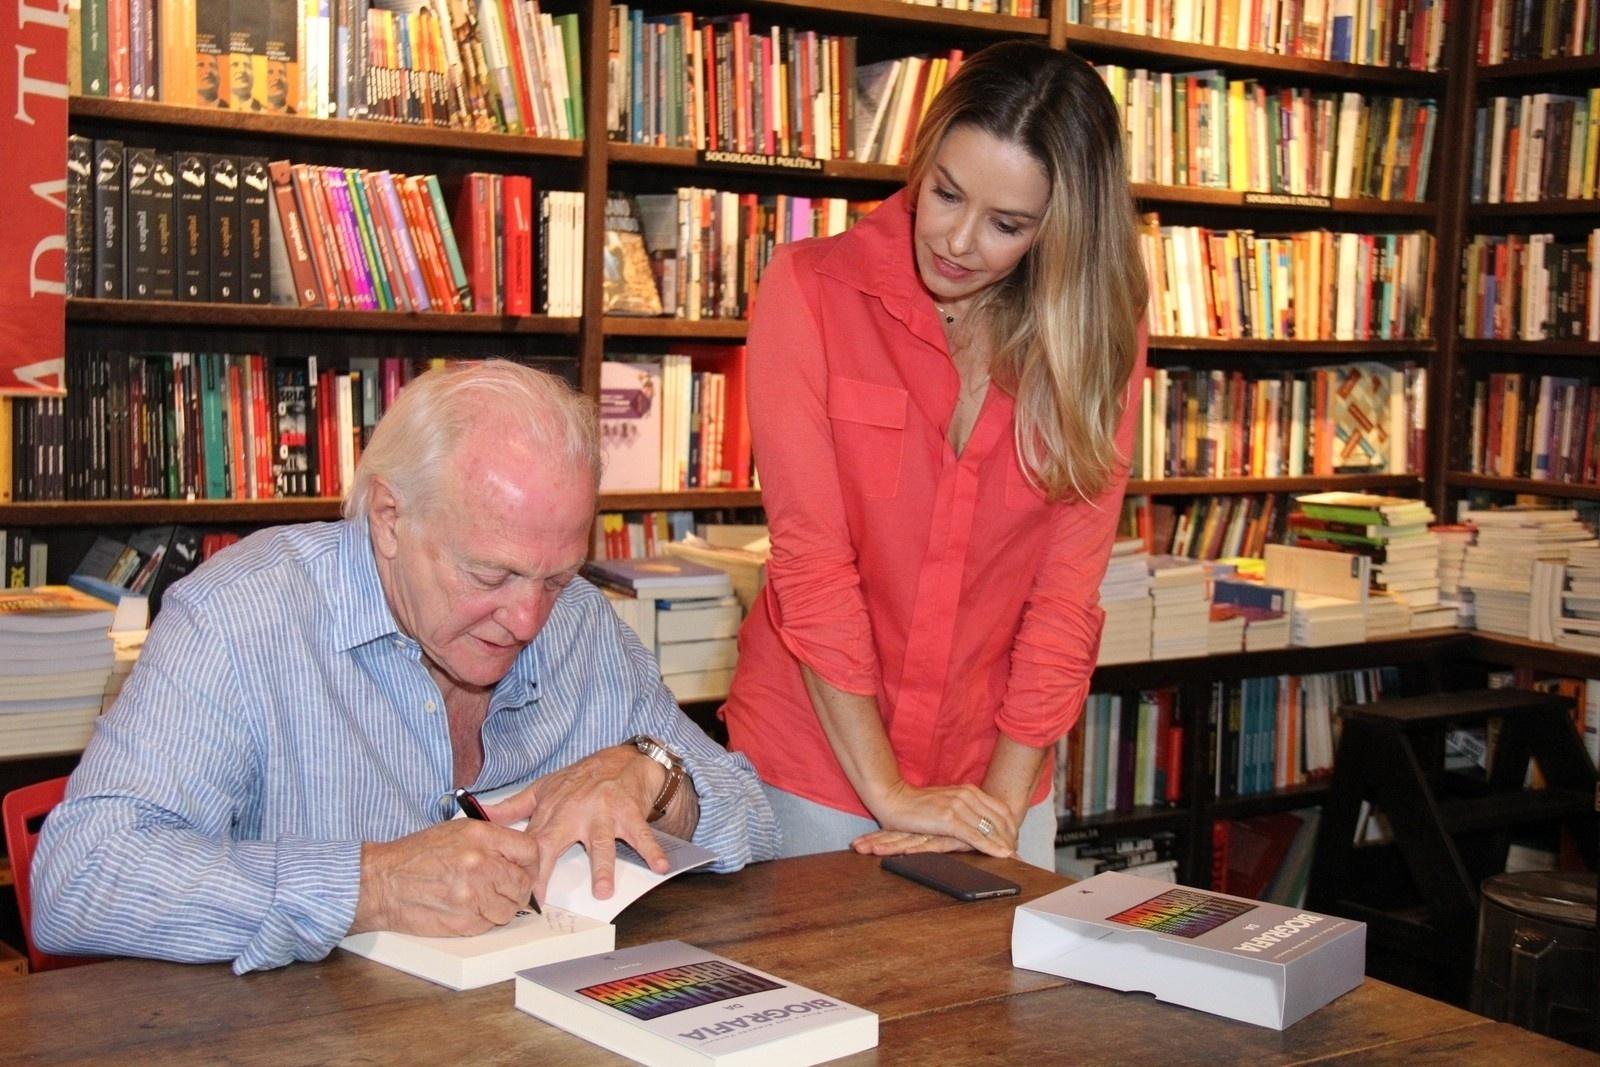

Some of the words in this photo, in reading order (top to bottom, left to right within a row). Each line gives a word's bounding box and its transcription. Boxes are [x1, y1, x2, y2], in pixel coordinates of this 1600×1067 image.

[705, 151, 767, 165] SOCIOLOGIA
[768, 156, 775, 166] E
[776, 156, 821, 169] POLÍTICA
[1231, 912, 1325, 953] BIOGRAFIA
[587, 960, 746, 1003] BRASILEIRA
[677, 997, 838, 1042] BIOGRAFIA
[722, 1003, 745, 1012] DA
